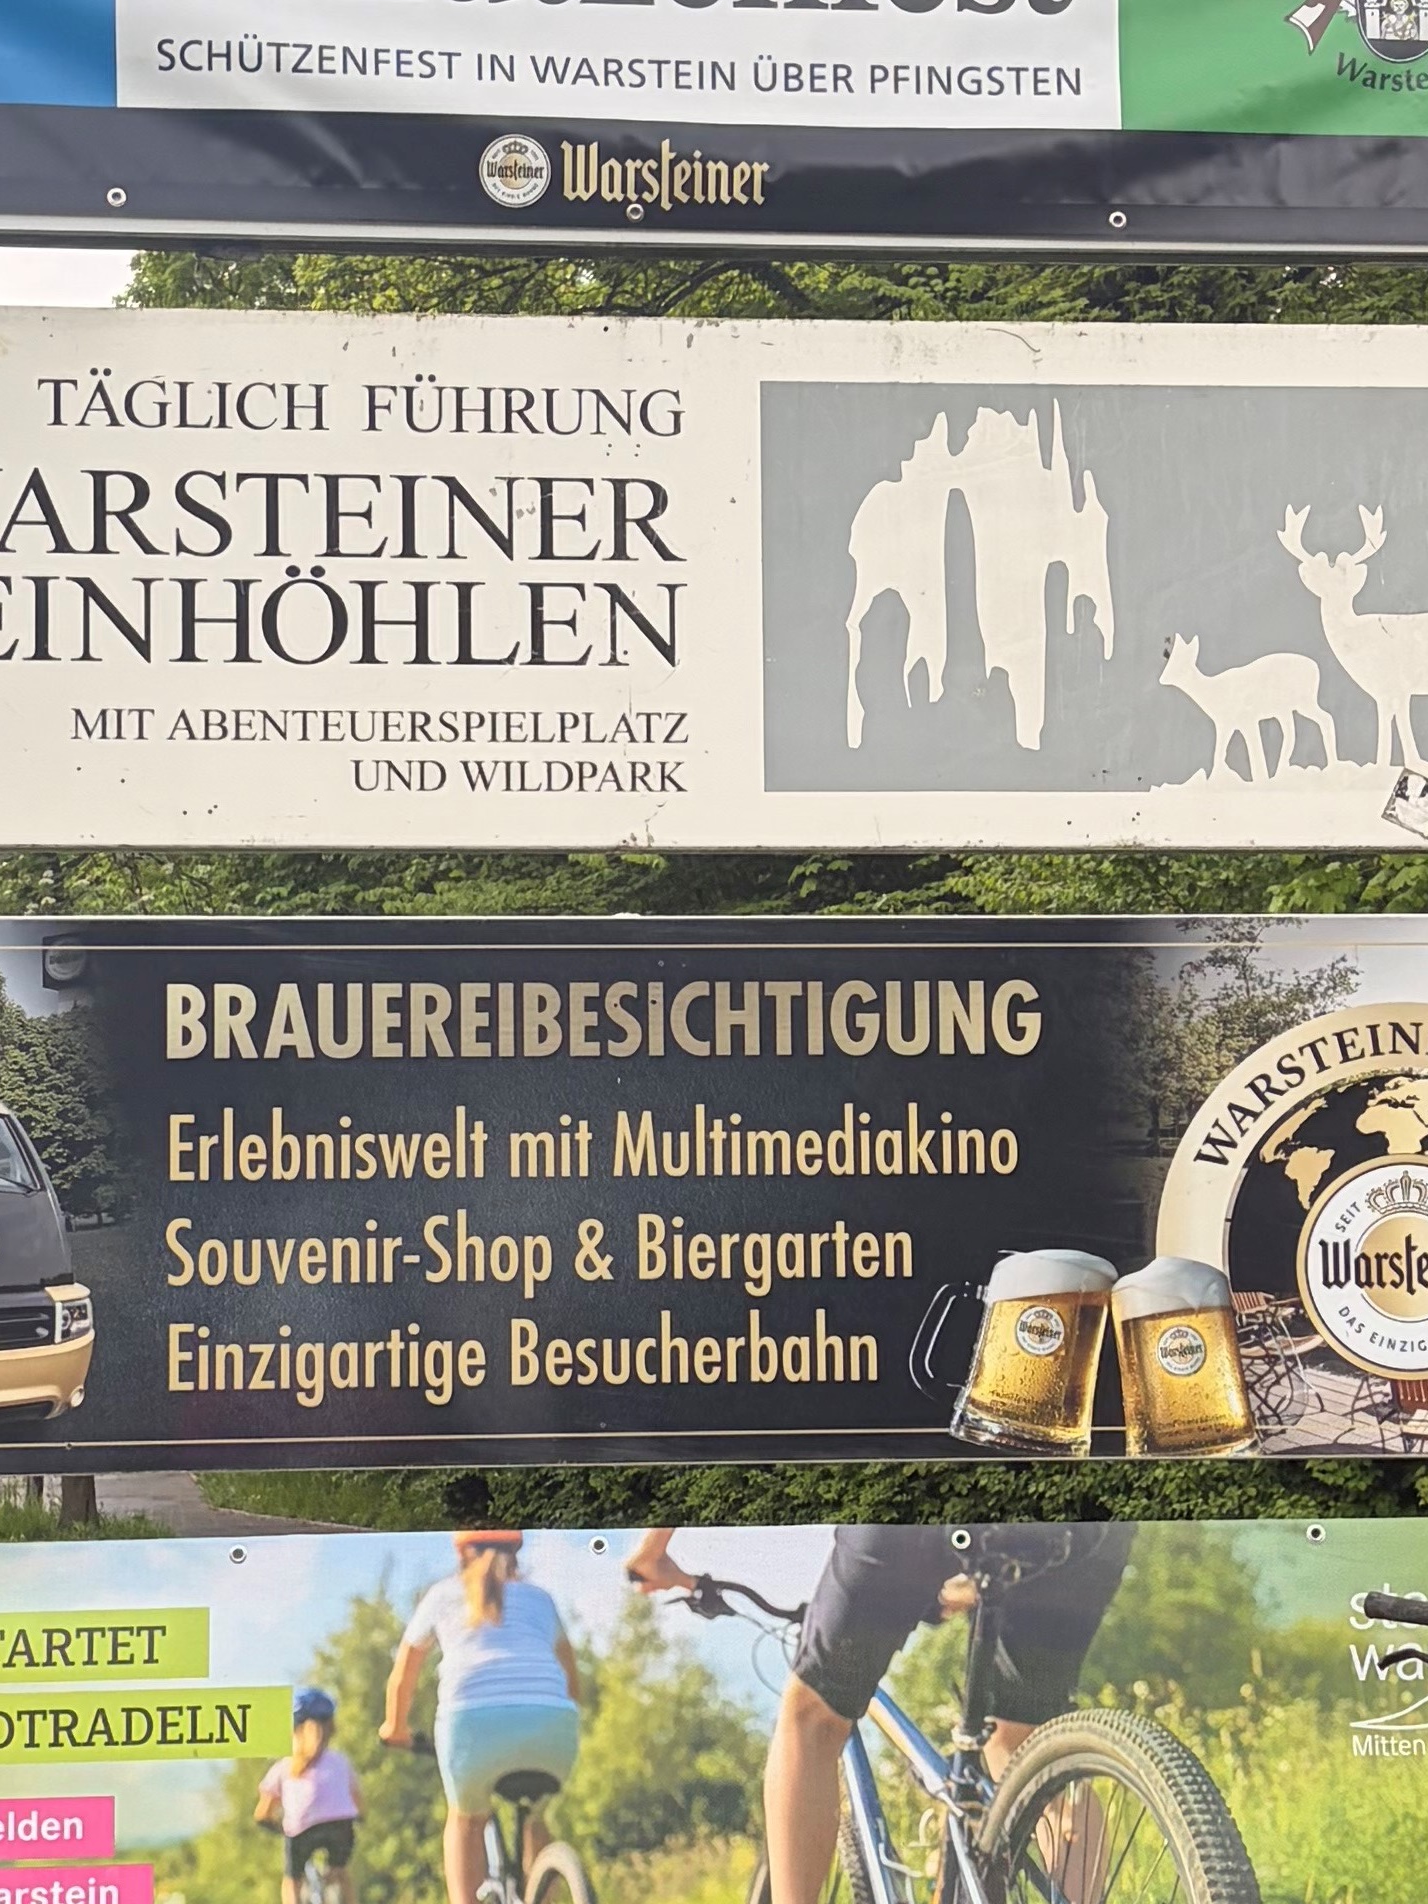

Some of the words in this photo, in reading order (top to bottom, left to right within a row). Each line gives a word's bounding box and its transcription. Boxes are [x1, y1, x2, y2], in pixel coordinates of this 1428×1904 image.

[157, 33, 462, 80] SCHÜTZENFEST
[477, 53, 515, 83] IN
[534, 55, 736, 91] WARSTEIN
[753, 54, 855, 94] ÜBER
[870, 64, 1081, 96] PFINGSTEN
[559, 137, 771, 212] Warsteiner
[37, 367, 330, 431] TÄGLICH
[362, 373, 685, 437] FÜHRUNG
[70, 708, 155, 740] MIT
[166, 708, 689, 744] ABENTEUERSPIELPLATZ
[352, 759, 447, 792] UND
[459, 760, 688, 793] WILDPARK
[166, 979, 1042, 1060] BRAUEREIBESICHTIGUNG
[169, 1105, 489, 1181] Erlebniswelt
[509, 1114, 593, 1178] mit
[613, 1102, 1018, 1177] Multimediakino
[1334, 1200, 1363, 1233] SEIT
[165, 1208, 553, 1299] Souvenir-Shop
[574, 1218, 614, 1281] &
[638, 1213, 913, 1297] Biergarten
[168, 1322, 486, 1408] Einzigartige
[510, 1308, 878, 1386] Besucherbahn
[1338, 1305, 1367, 1335] DAS
[1369, 1331, 1428, 1353] EINZIG
[1351, 1733, 1427, 1757] Mitten
